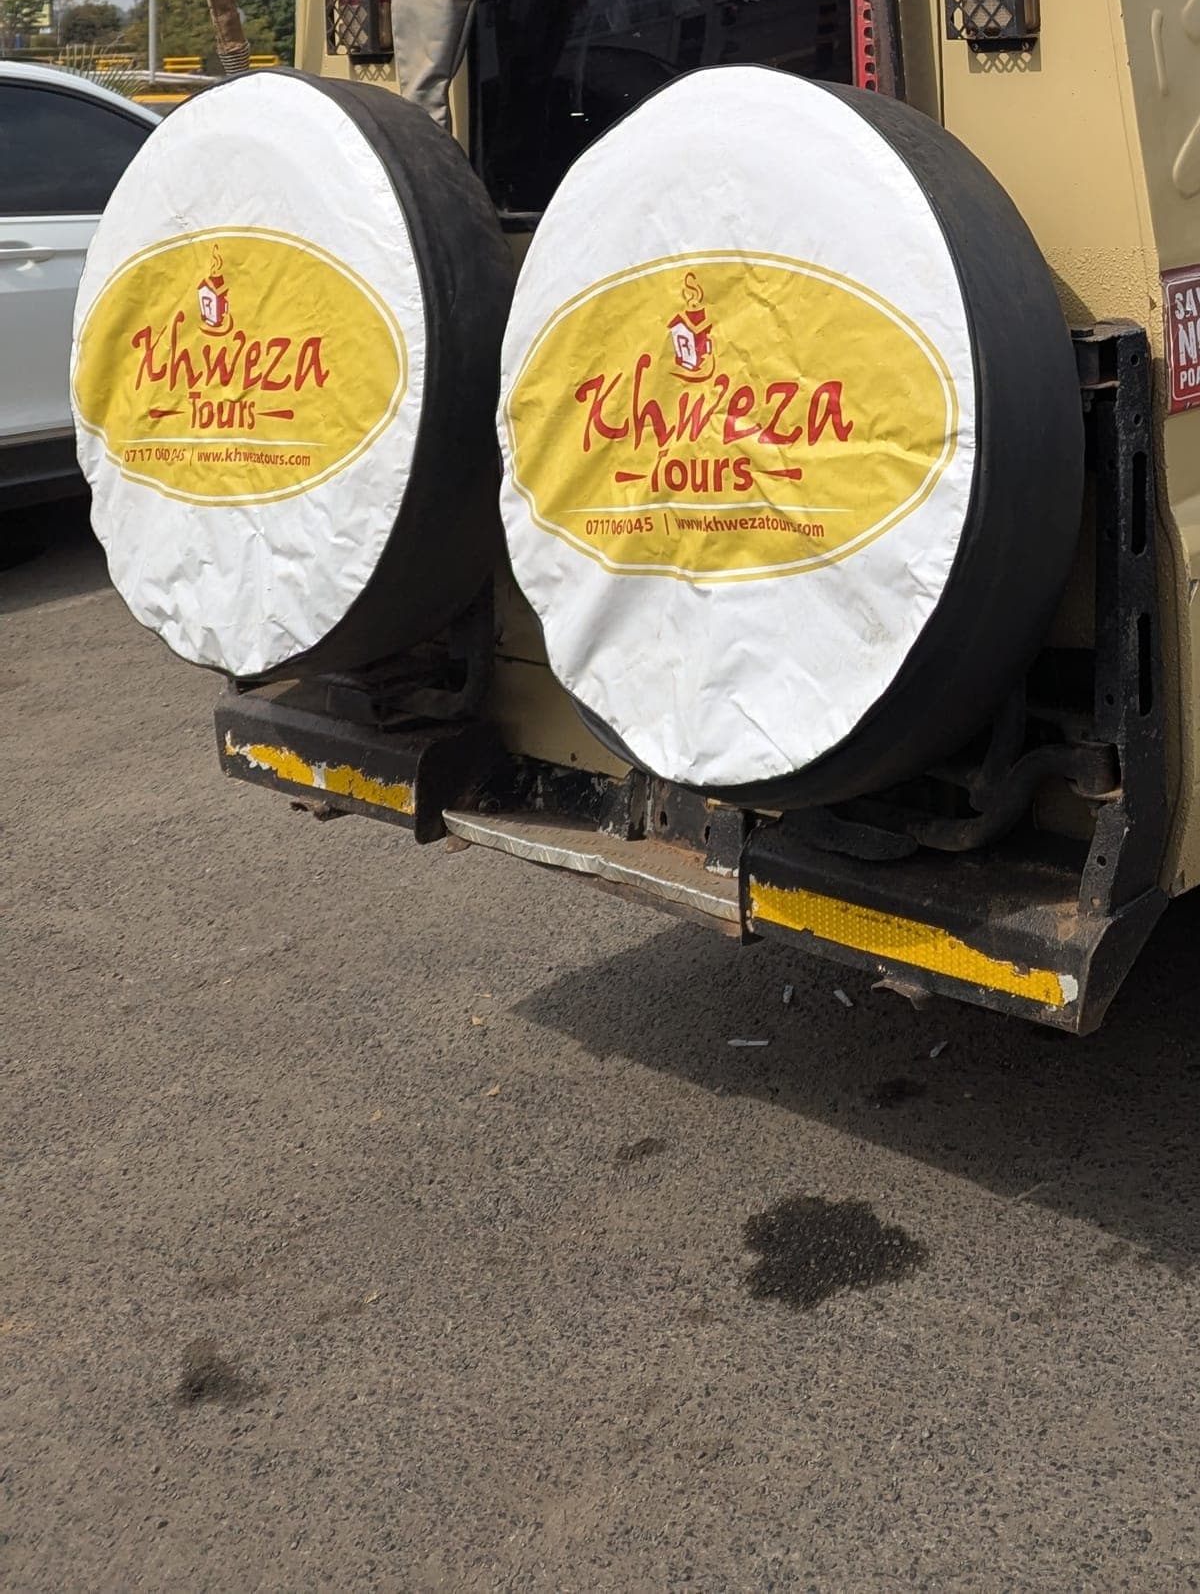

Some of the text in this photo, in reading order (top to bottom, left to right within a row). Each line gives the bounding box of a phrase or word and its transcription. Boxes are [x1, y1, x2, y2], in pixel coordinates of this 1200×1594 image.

[131, 310, 330, 391] Khweza
[188, 391, 256, 429] Tours
[574, 353, 854, 453] Khweza
[124, 448, 152, 463] 0717
[651, 449, 754, 493] Tours
[675, 514, 825, 538] www.khwezatourscom
